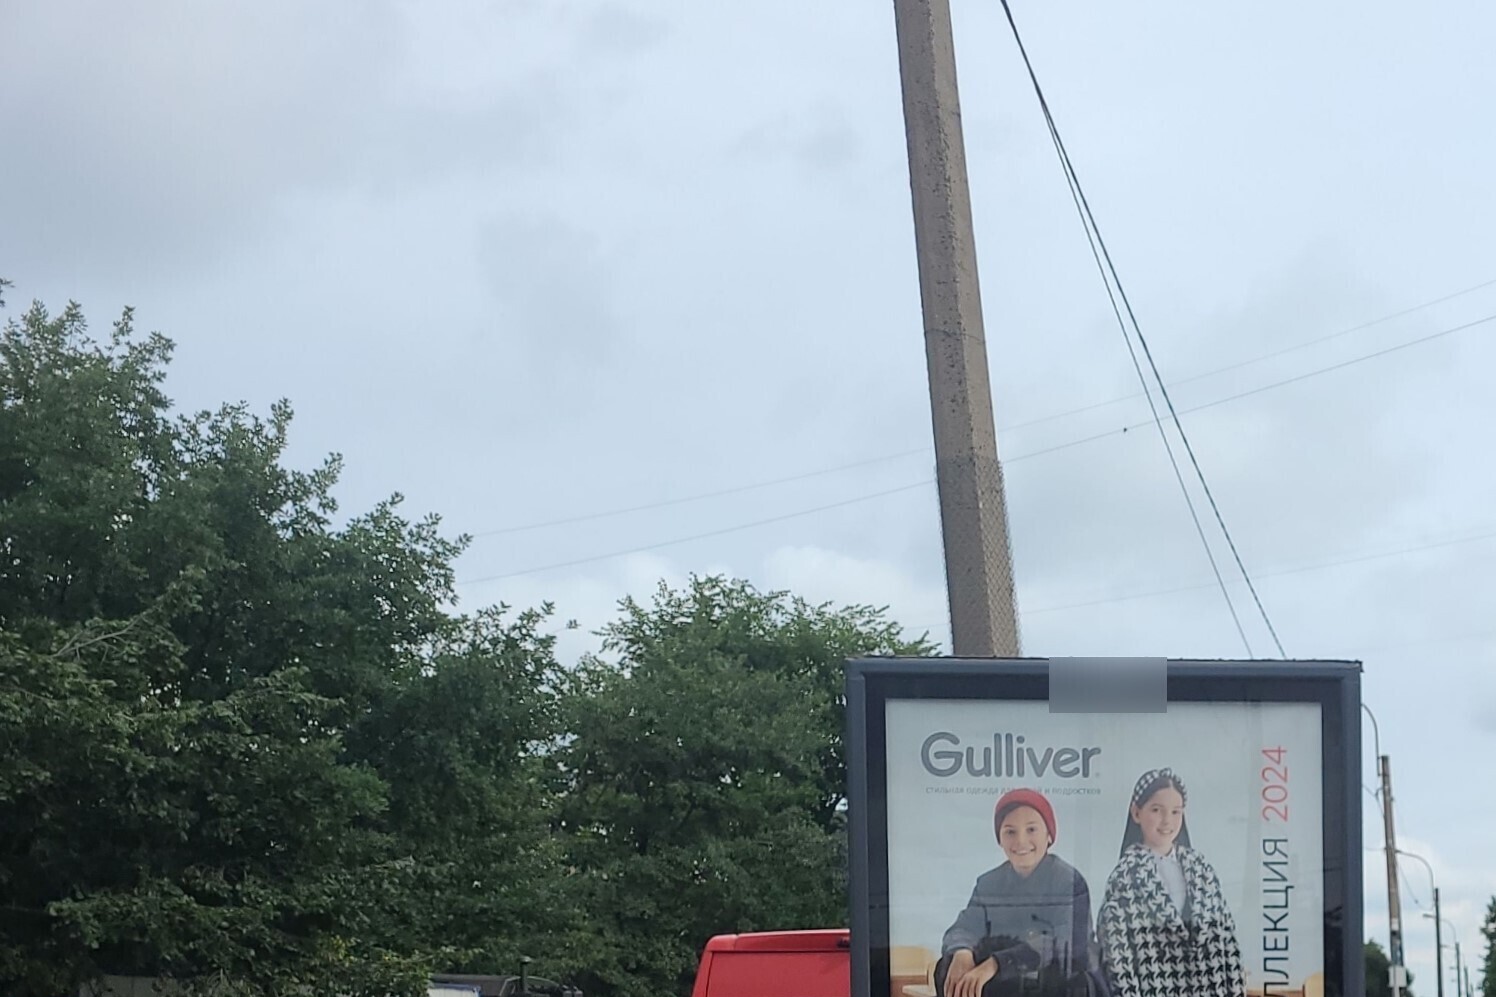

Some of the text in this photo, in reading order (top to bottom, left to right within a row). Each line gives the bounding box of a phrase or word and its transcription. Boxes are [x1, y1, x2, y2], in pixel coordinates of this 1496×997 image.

[921, 731, 1102, 779] Gulliver
[925, 786, 965, 794] стильная
[966, 786, 999, 795] одежда
[1261, 745, 1289, 822] 2024
